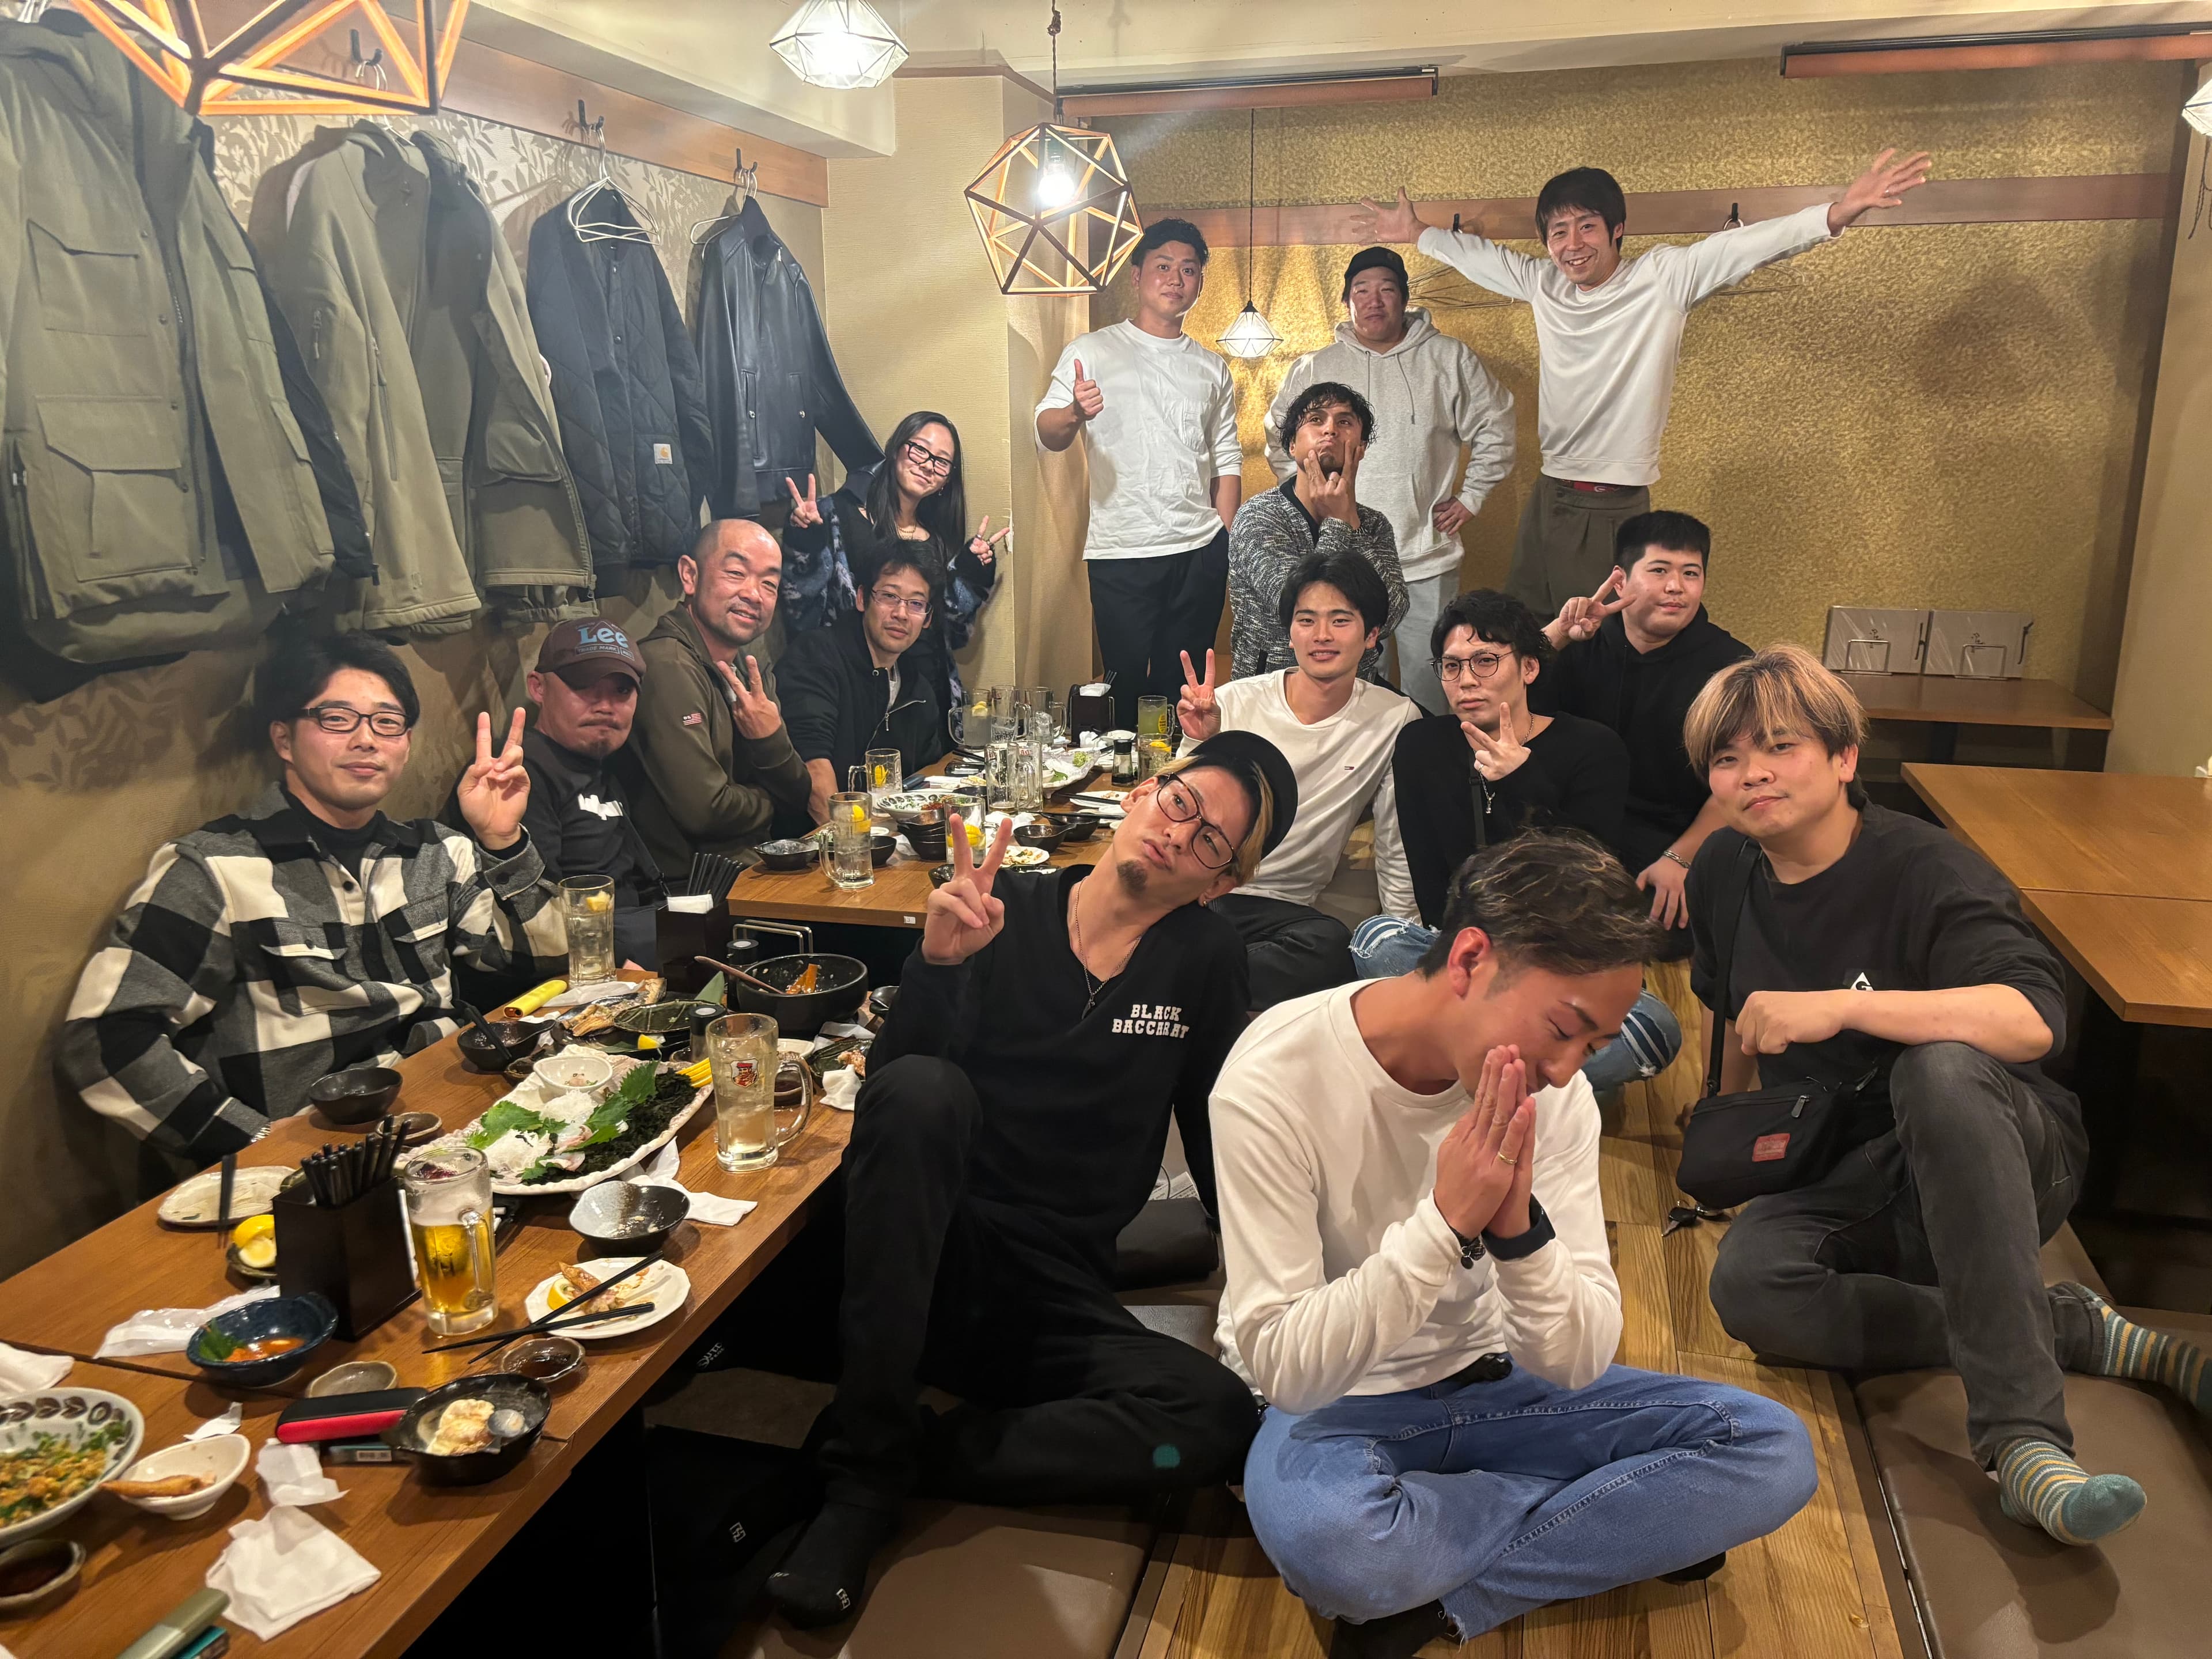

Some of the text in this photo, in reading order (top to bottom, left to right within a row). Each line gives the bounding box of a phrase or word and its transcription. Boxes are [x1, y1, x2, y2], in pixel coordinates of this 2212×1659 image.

[578, 627, 629, 648] Lee
[1130, 1004, 1182, 1021] BLACK
[1112, 1018, 1190, 1039] BACCARAT
